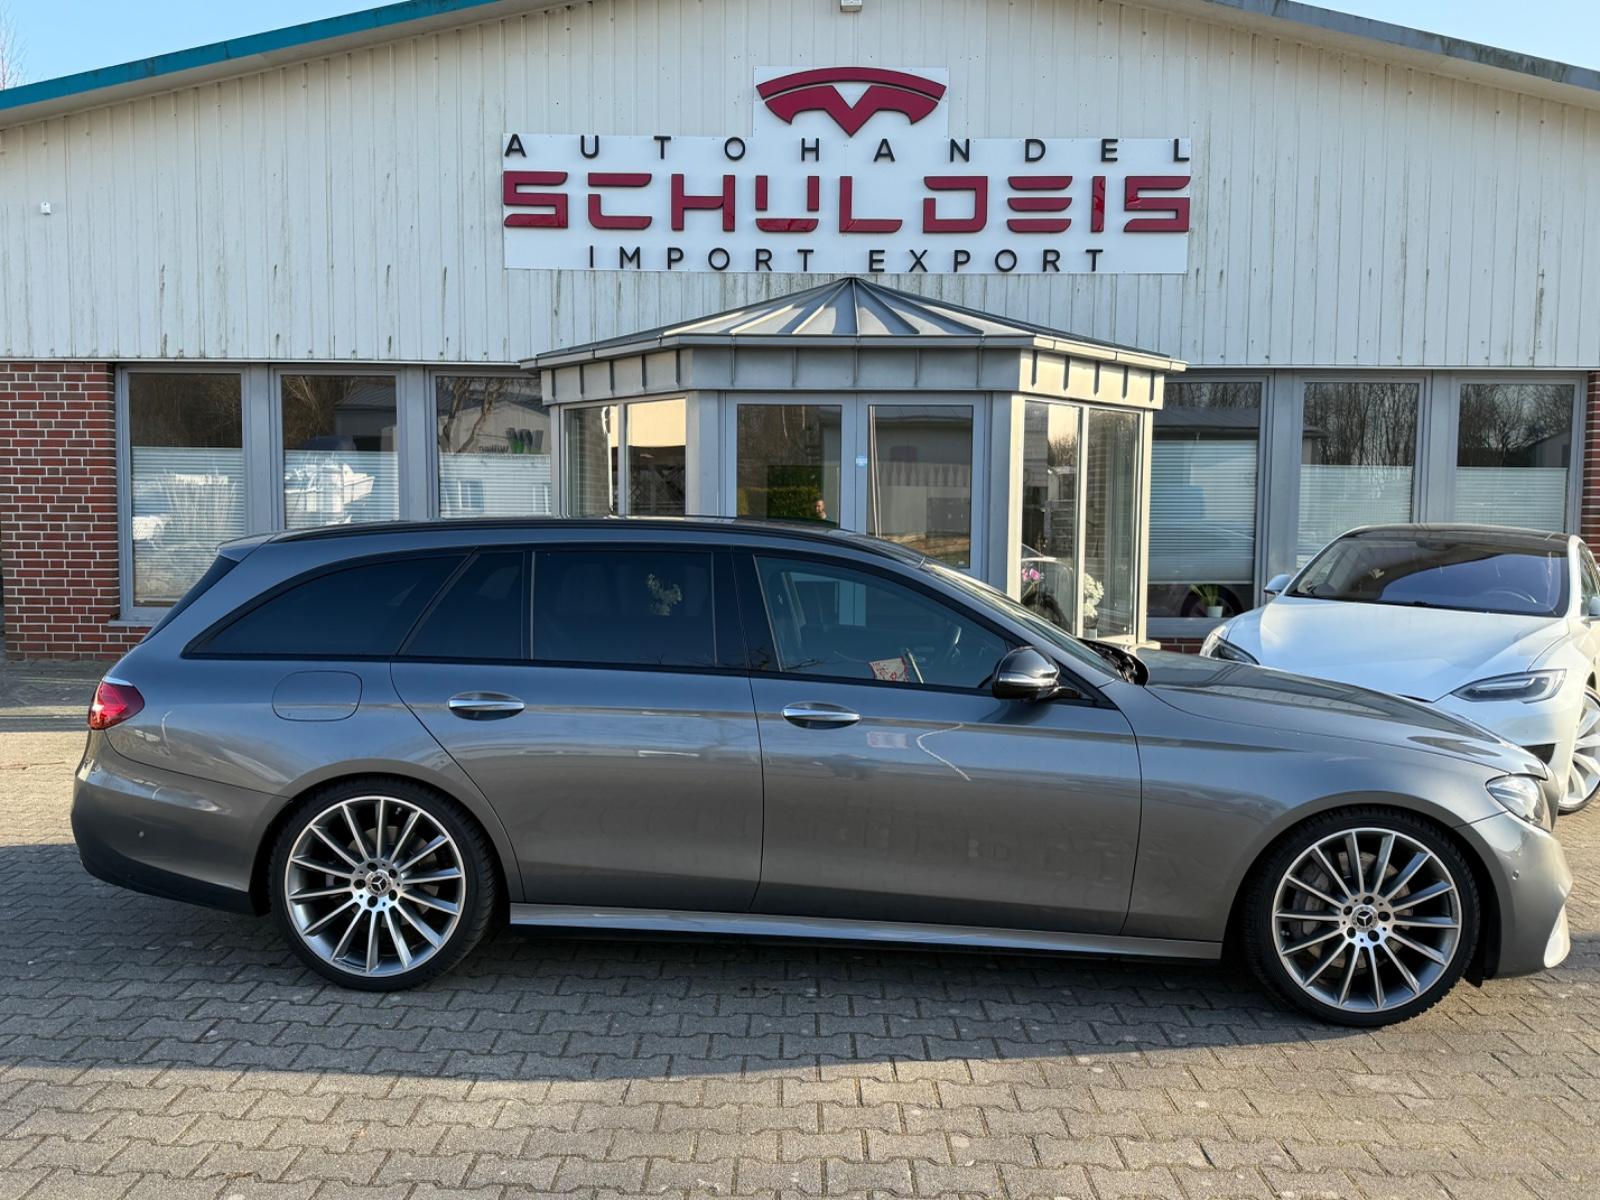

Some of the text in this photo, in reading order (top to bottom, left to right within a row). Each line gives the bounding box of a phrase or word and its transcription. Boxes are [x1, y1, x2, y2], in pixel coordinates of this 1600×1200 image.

[503, 133, 1191, 163] AUTOHANDEL
[503, 170, 1191, 233] SCHULDEIS
[588, 245, 1104, 273] IMPORT EXPORT
